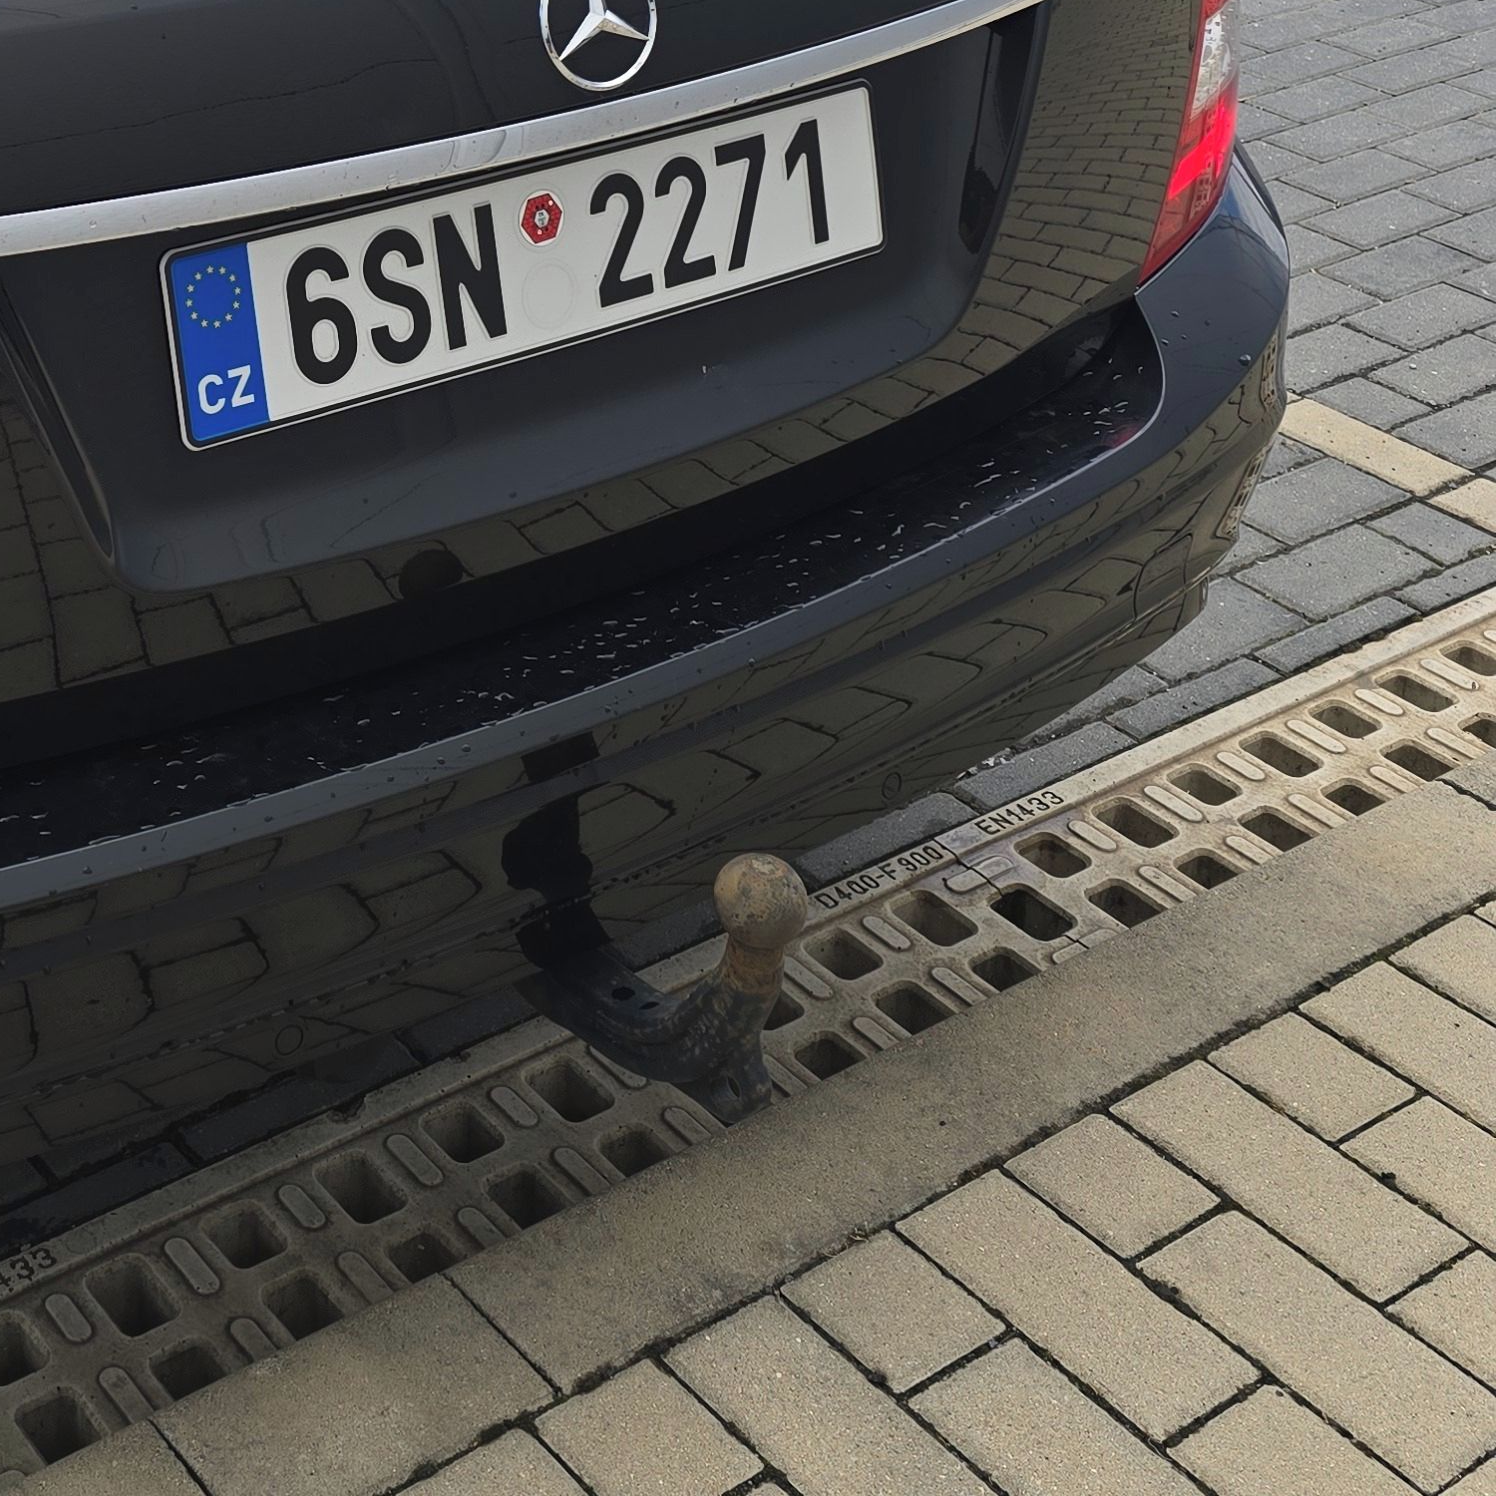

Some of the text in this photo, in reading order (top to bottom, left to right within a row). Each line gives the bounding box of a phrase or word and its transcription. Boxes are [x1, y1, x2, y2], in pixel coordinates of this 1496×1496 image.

[286, 118, 831, 385] 6SN 2271
[197, 365, 256, 415] CZ
[974, 790, 1065, 836] EN1433
